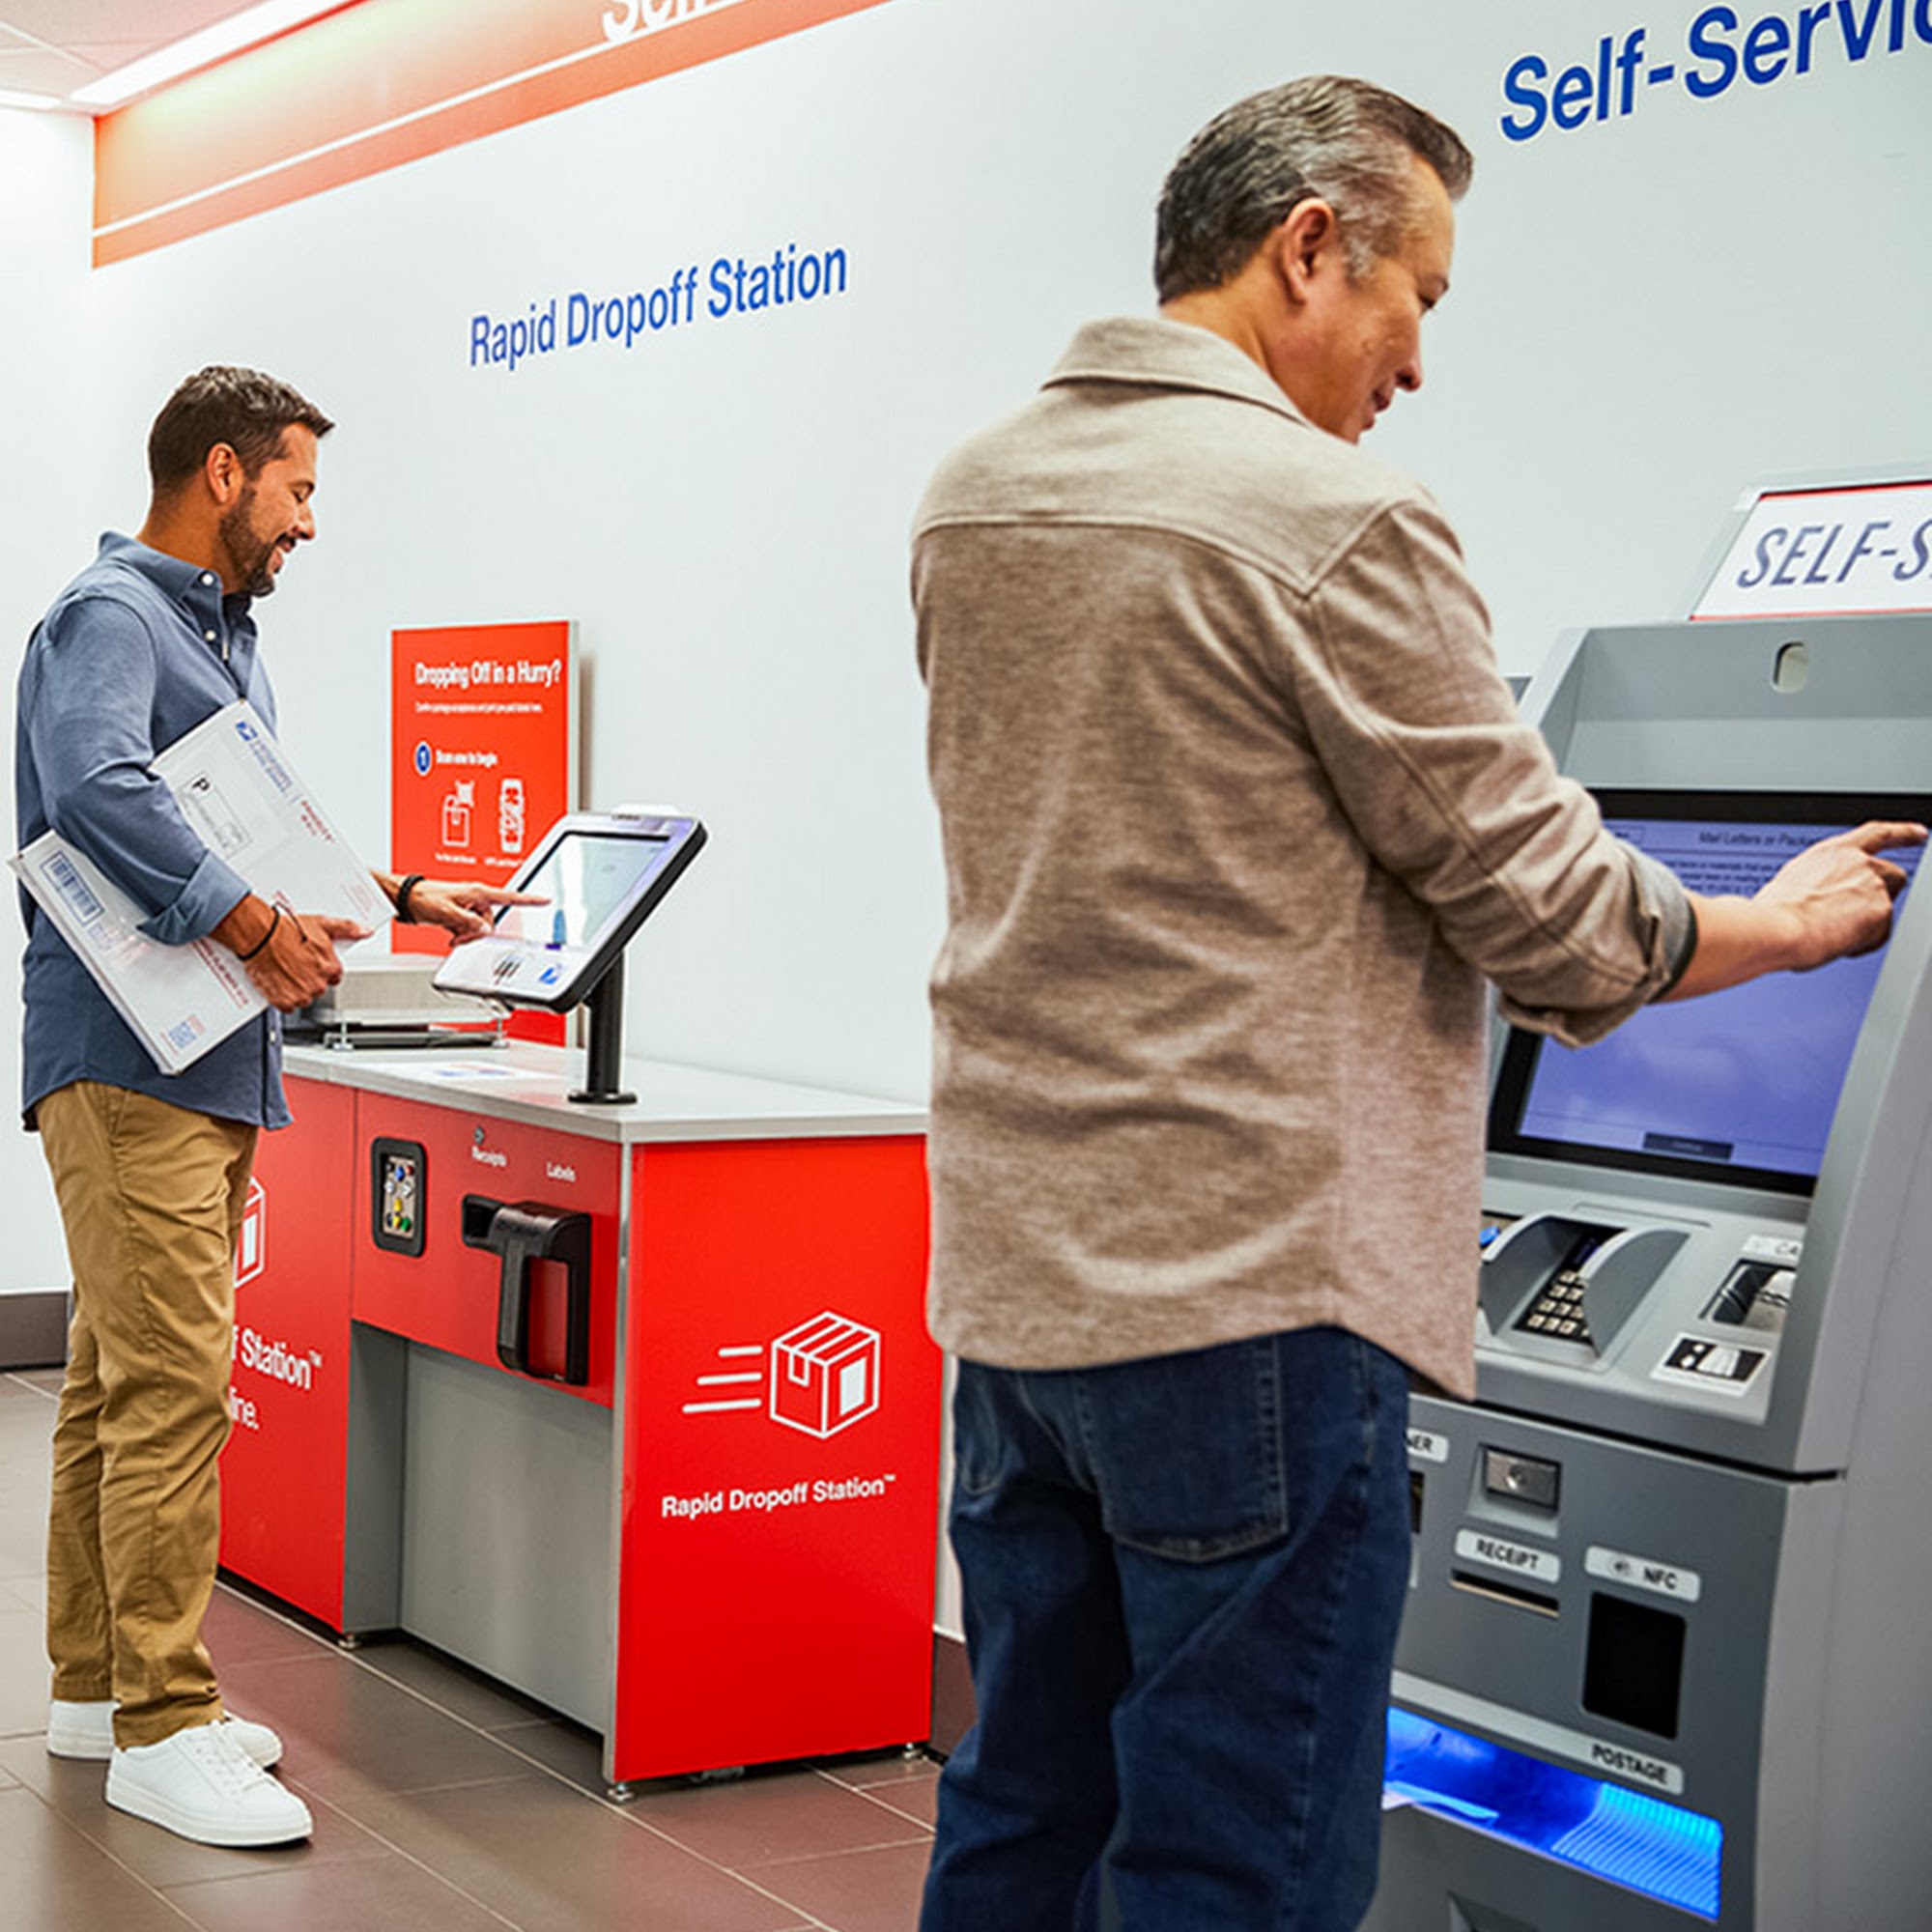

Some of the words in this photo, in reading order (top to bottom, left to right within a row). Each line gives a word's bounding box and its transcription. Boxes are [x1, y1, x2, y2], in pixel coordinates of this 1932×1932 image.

[470, 298, 556, 371] Rapid
[566, 266, 697, 349] Dropoff
[707, 243, 848, 318] Station
[1736, 518, 1932, 588] SELF-S
[415, 662, 469, 690] Dropping
[471, 661, 490, 684] Off
[507, 666, 515, 684] a
[517, 659, 562, 689] Hurry?
[192, 777, 210, 792] P
[546, 1161, 576, 1182] Labels
[662, 1492, 724, 1520] Rapid
[728, 1482, 810, 1512] Dropoff
[1476, 1538, 1540, 1570] RECEIPT
[1643, 1565, 1679, 1591] NFC
[1592, 1743, 1668, 1785] POSTAGE
